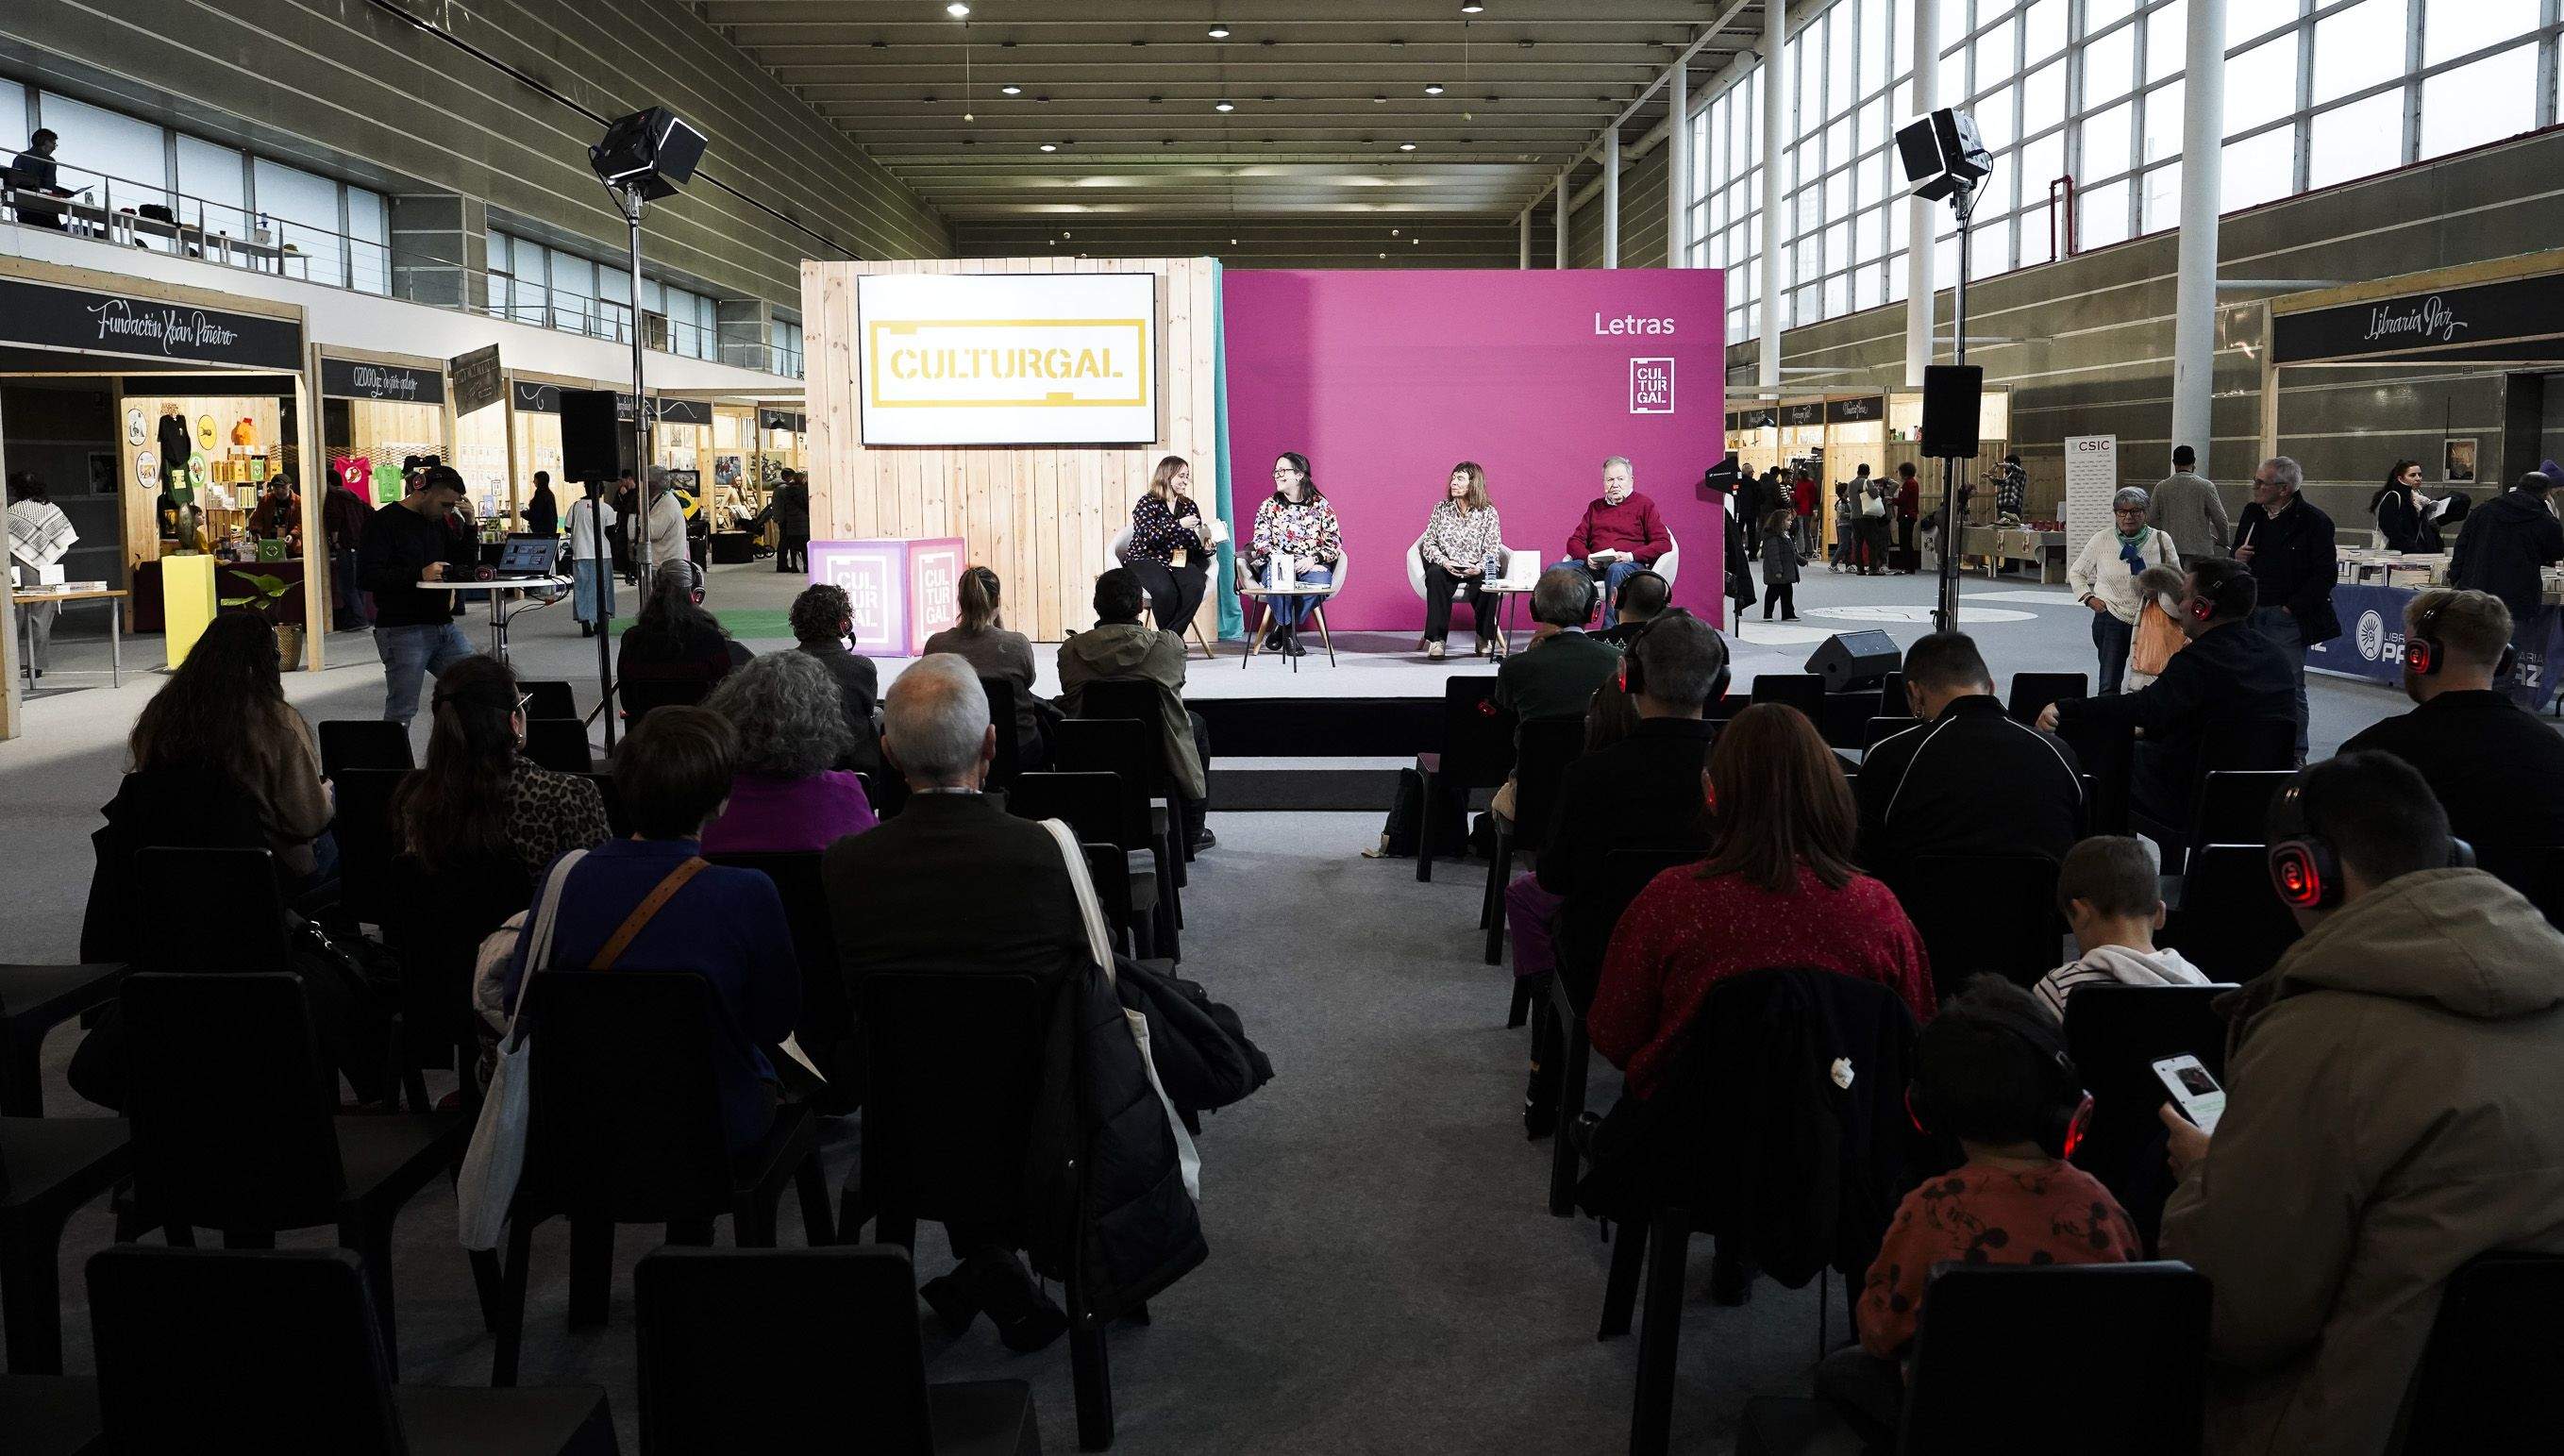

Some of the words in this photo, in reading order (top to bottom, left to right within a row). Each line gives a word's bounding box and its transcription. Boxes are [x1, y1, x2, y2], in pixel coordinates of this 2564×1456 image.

[87, 299, 162, 340] Fundación
[192, 310, 238, 347] Piñeiro
[1595, 311, 1675, 335] Letras
[2423, 295, 2469, 341] Paz
[890, 347, 1124, 379] CULTURGAL
[1636, 367, 1667, 379] CUL
[1637, 379, 1667, 392] TUR
[1636, 392, 1667, 404] GAL
[2079, 440, 2110, 452] CSIC
[836, 571, 877, 590] CUL
[925, 568, 949, 588] CUL
[851, 589, 879, 610] UR
[927, 585, 950, 605] TUR
[853, 609, 879, 628] AL
[926, 605, 950, 625] GAL
